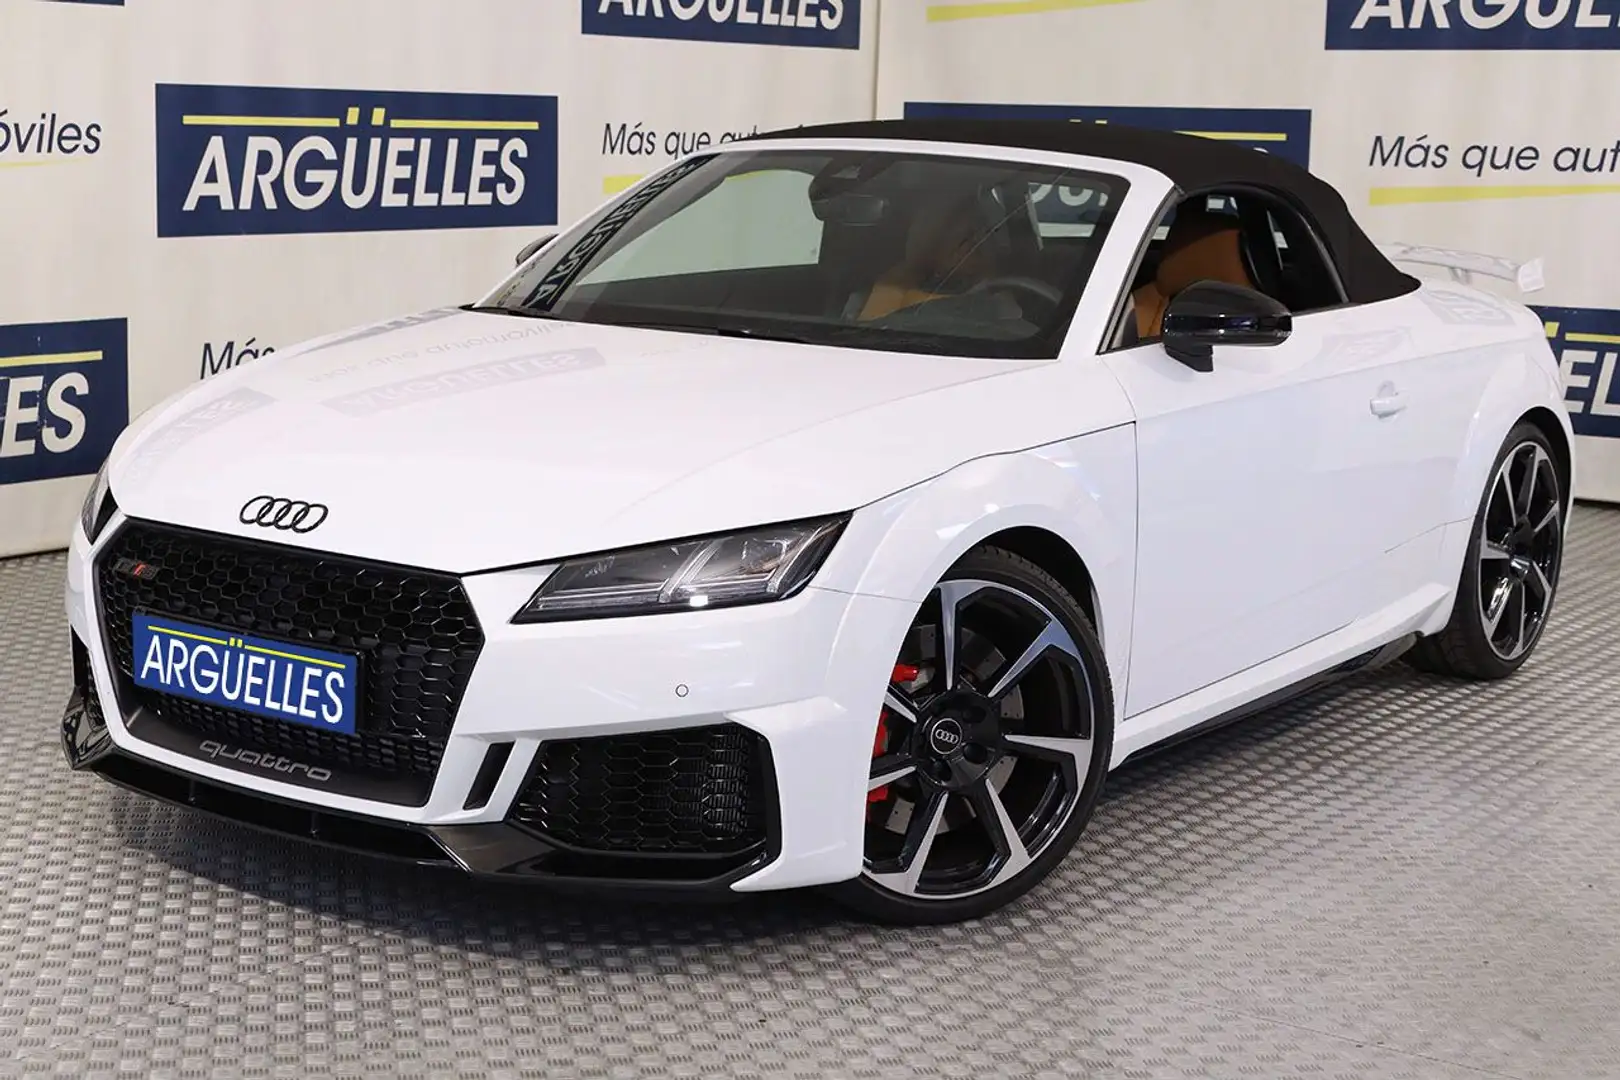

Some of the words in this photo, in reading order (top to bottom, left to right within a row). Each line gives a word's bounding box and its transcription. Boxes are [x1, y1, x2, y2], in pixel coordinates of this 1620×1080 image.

[182, 107, 528, 211] ARGÜELLES
[602, 122, 657, 155] Más
[664, 131, 711, 160] que
[1369, 134, 1449, 169] Más
[1461, 145, 1540, 177] que
[1545, 322, 1620, 416] EL
[140, 635, 345, 724] ARGÜELLES
[199, 739, 332, 781] quattro
